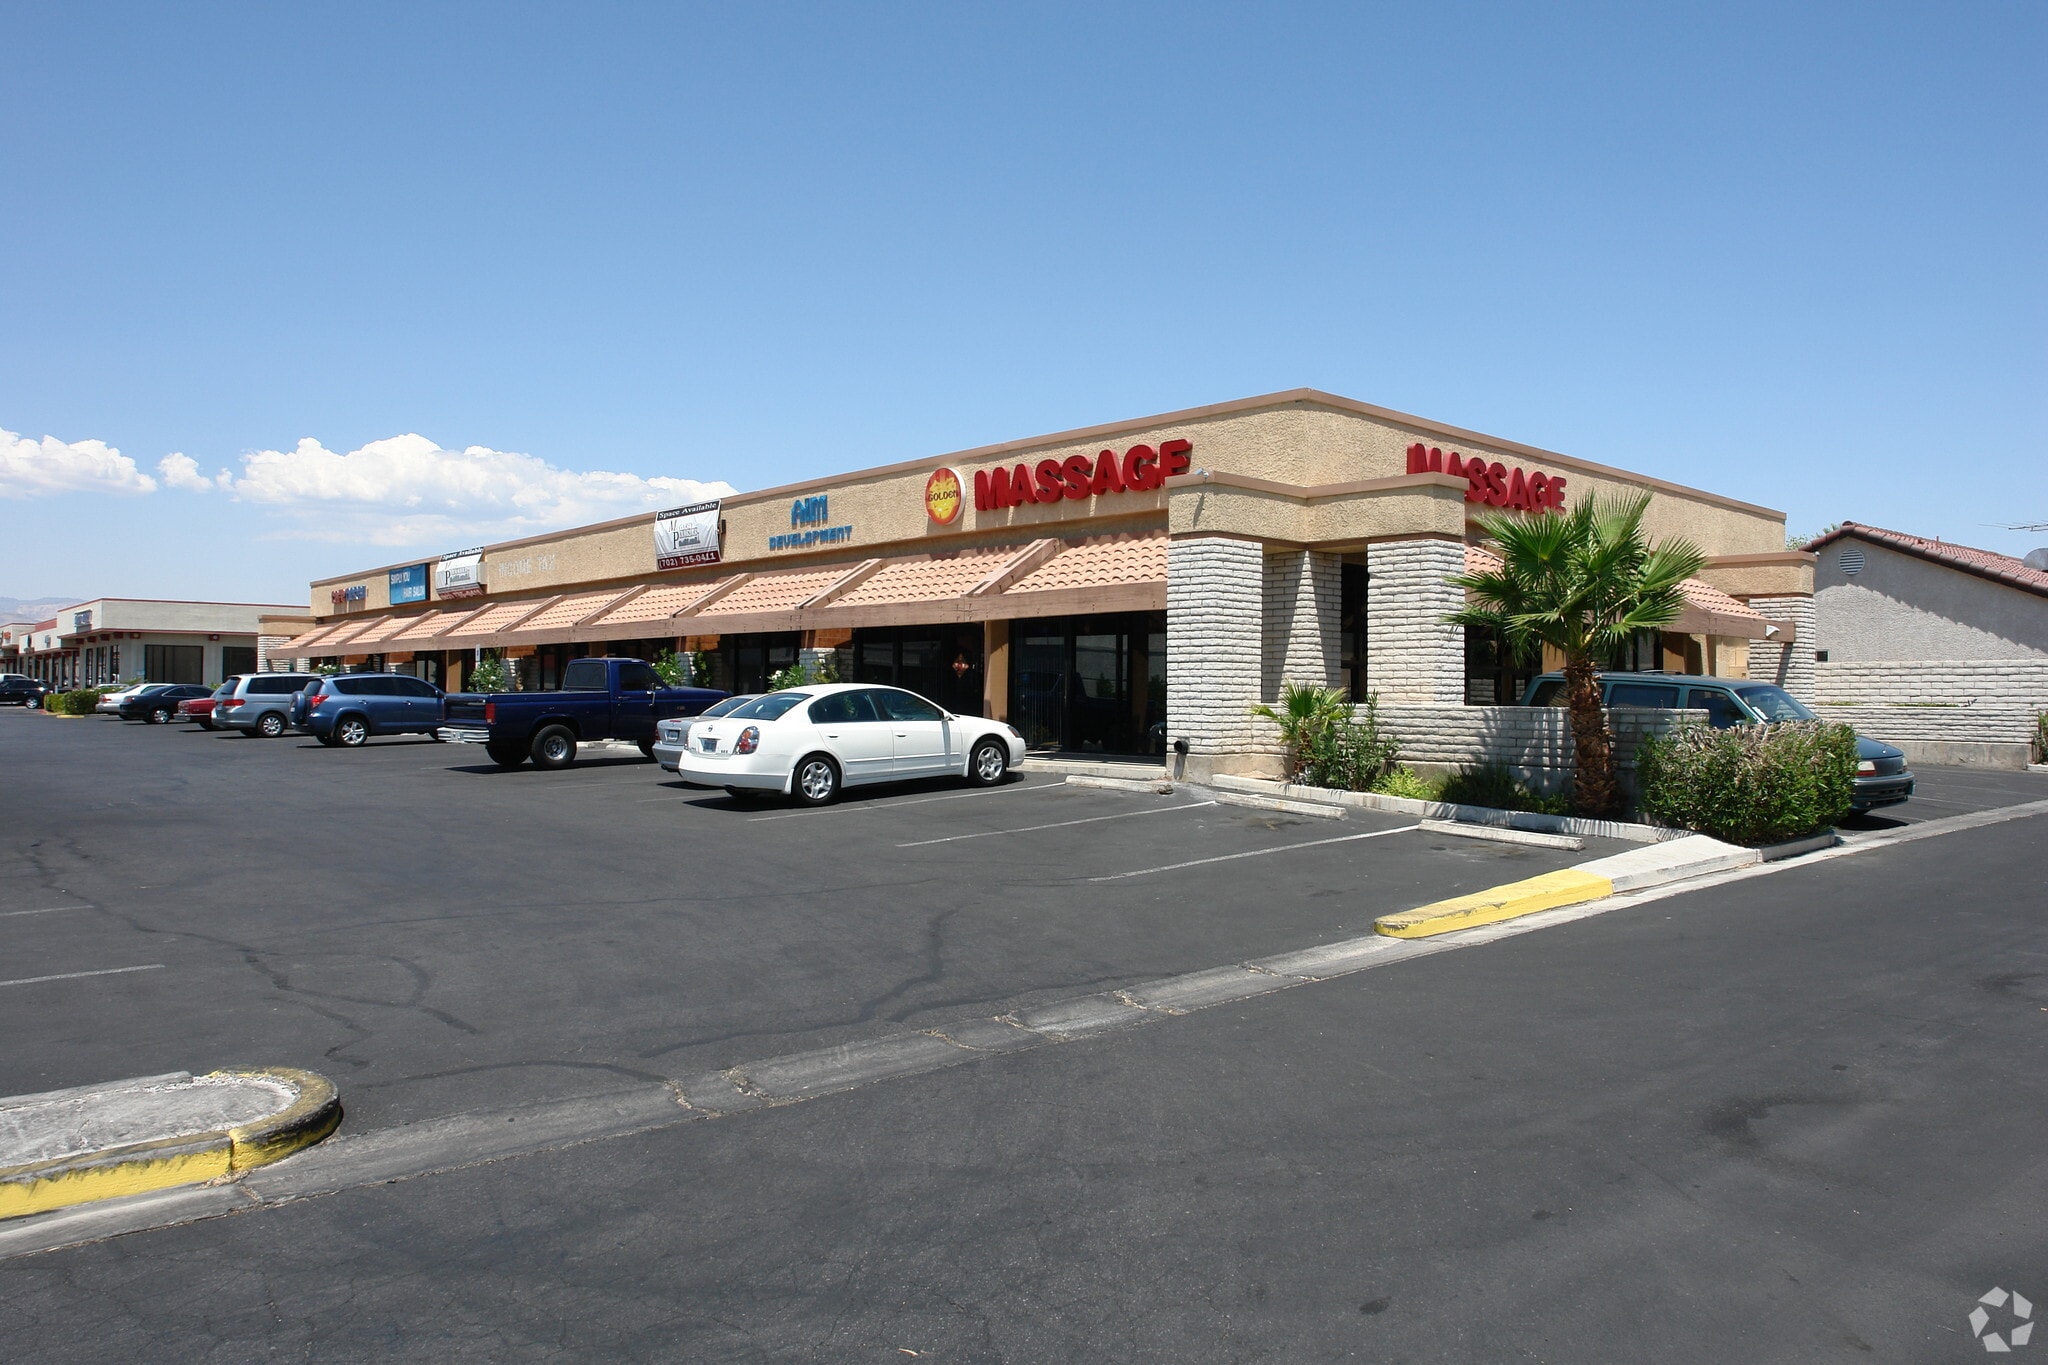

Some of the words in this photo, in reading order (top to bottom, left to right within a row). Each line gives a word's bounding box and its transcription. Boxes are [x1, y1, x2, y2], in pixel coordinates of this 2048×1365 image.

[974, 438, 1193, 511] MASSAGE
[928, 490, 959, 502] GOLDEN
[658, 509, 680, 519] Space
[681, 502, 717, 514] Available
[791, 495, 828, 523] AIM
[768, 525, 853, 548] DEVELOPMENT
[659, 558, 678, 568] (702)
[680, 552, 716, 564] 735-0411
